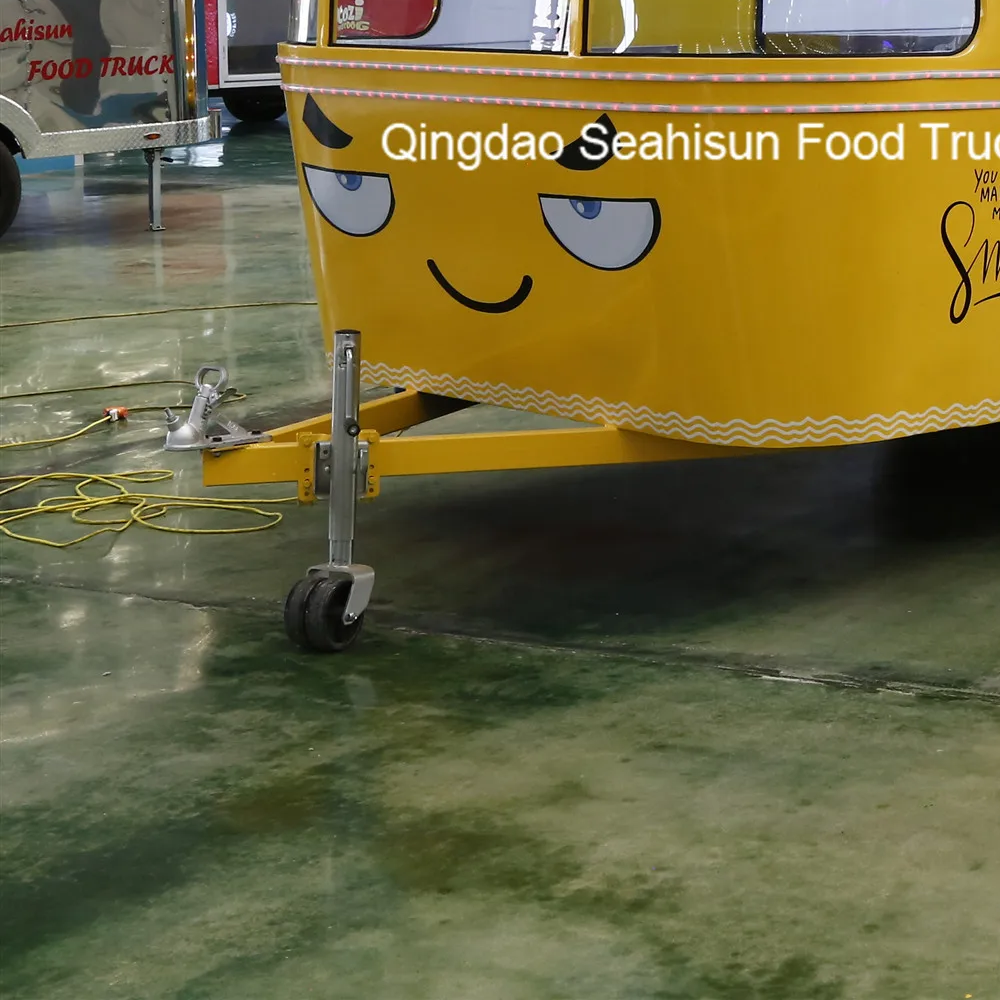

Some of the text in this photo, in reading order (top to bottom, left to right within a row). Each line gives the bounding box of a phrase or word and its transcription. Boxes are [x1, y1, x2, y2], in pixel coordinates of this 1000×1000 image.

[0, 18, 73, 43] ahisun
[27, 54, 175, 81] FOOD TRUCK
[974, 168, 999, 193] YOU
